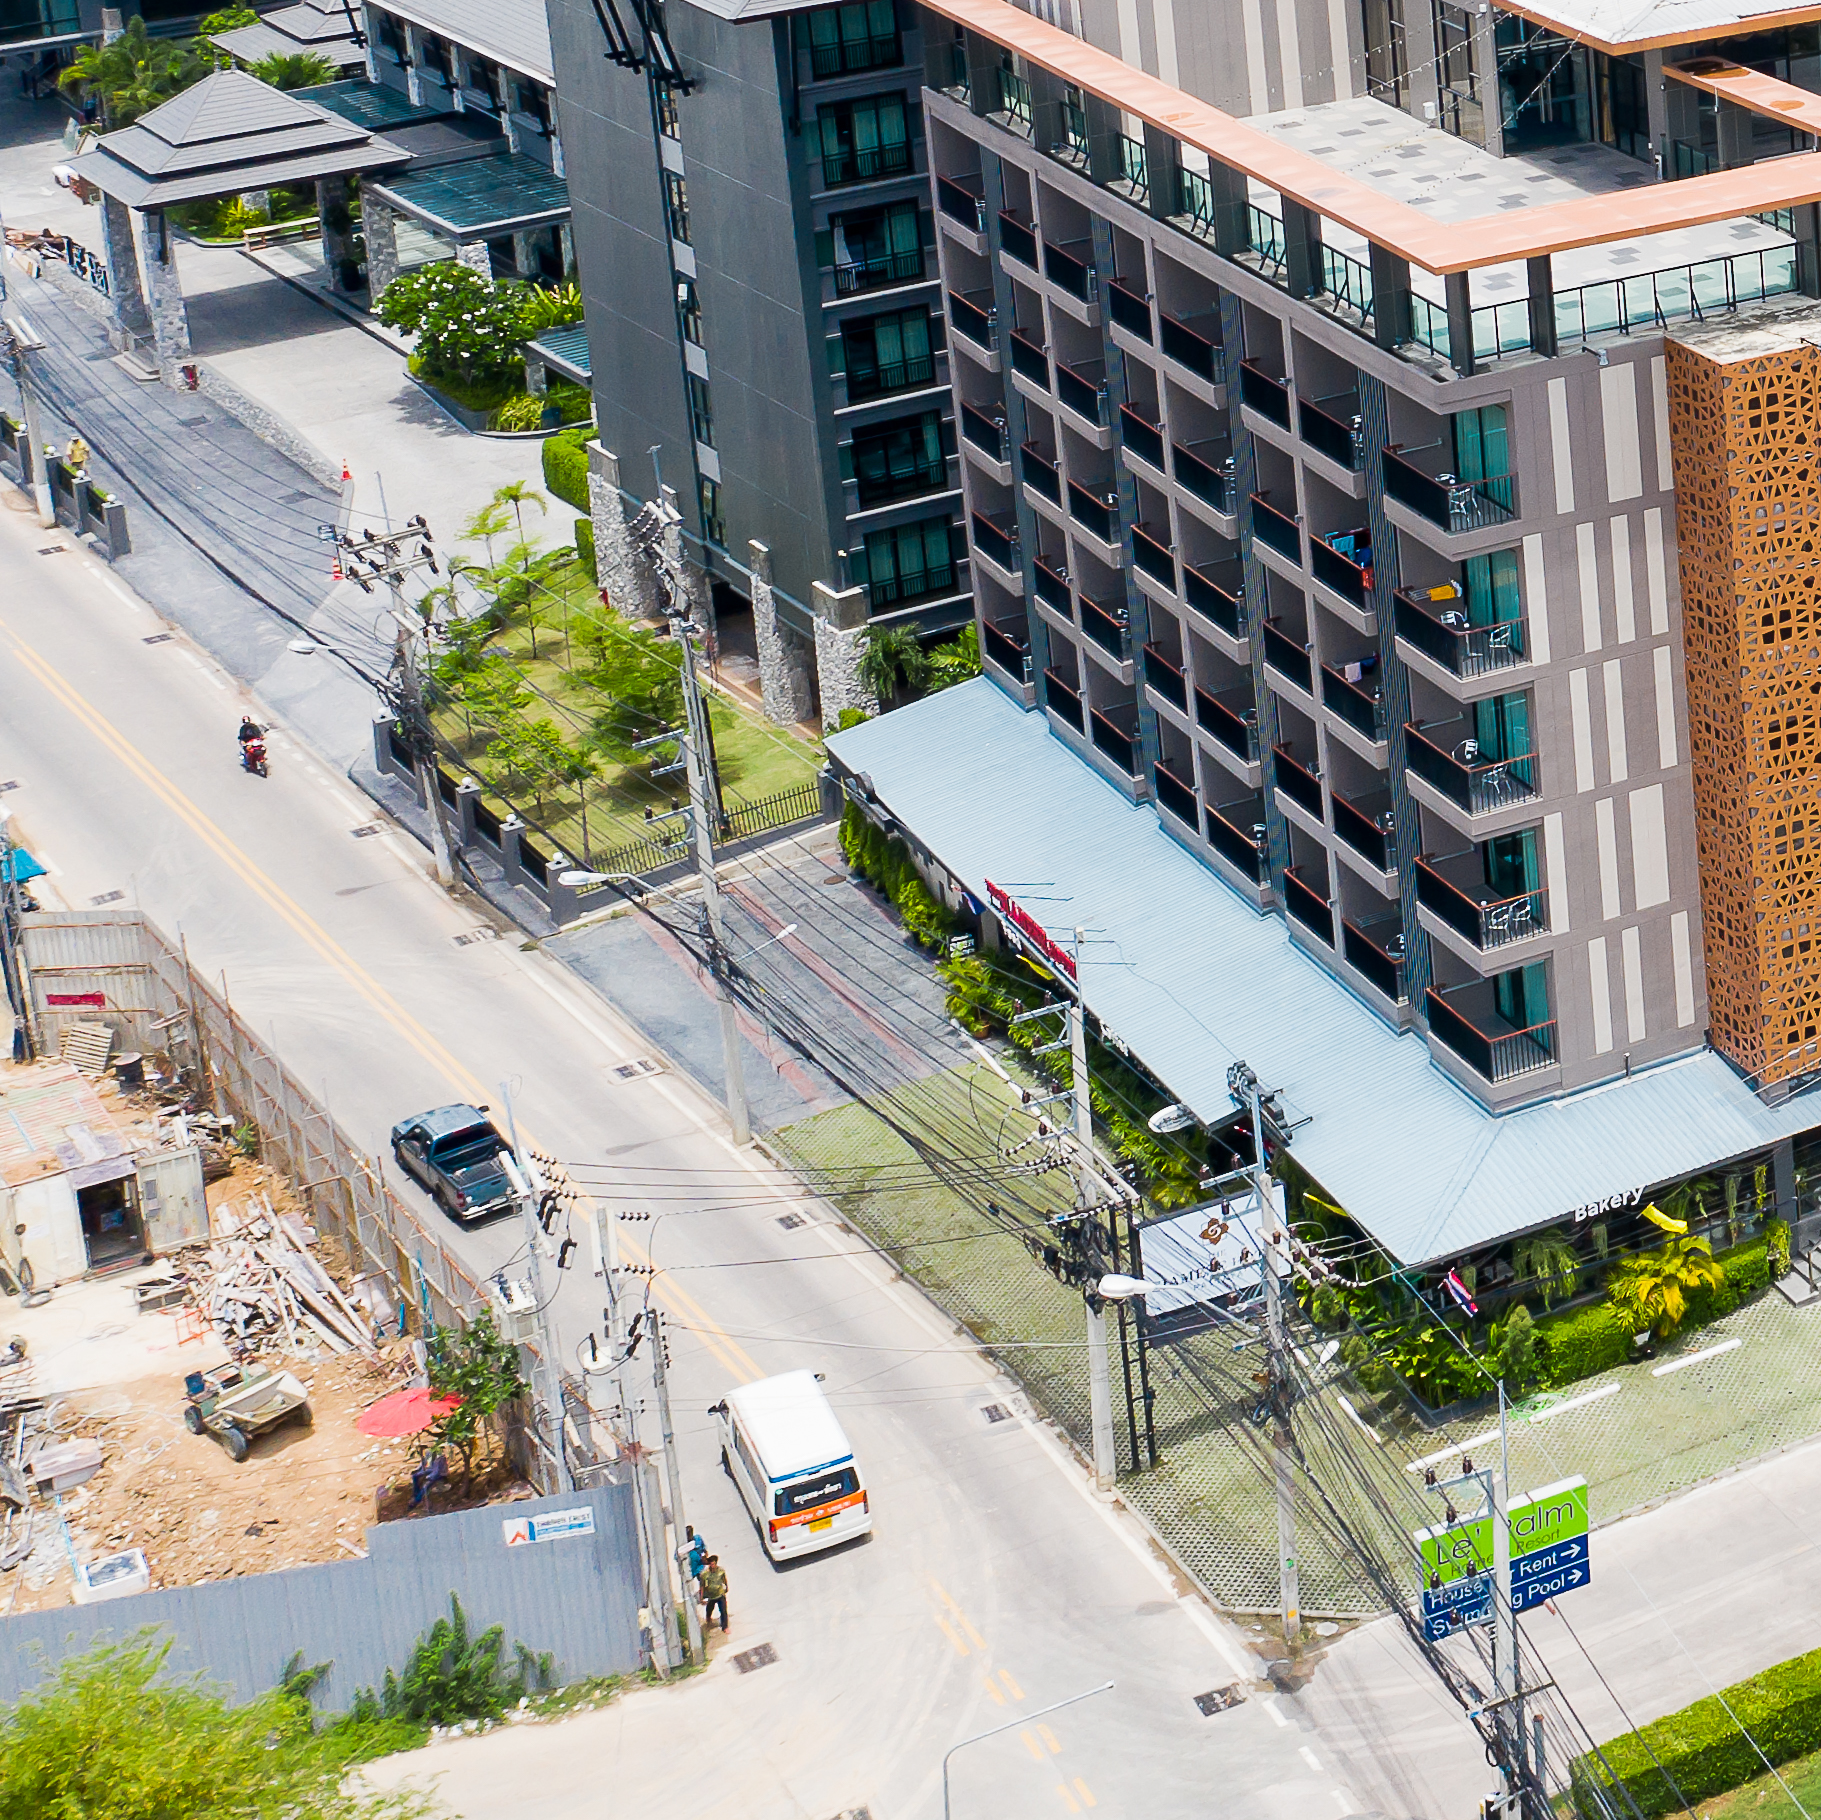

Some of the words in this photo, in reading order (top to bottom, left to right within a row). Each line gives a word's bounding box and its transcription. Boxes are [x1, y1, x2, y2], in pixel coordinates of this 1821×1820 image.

[1574, 1184, 1648, 1223] Bakery
[1508, 1501, 1574, 1537] alm
[1516, 1528, 1561, 1554] Resort
[1430, 1581, 1484, 1610] House
[1519, 1550, 1559, 1578] Rent
[1528, 1573, 1565, 1601] Pool
